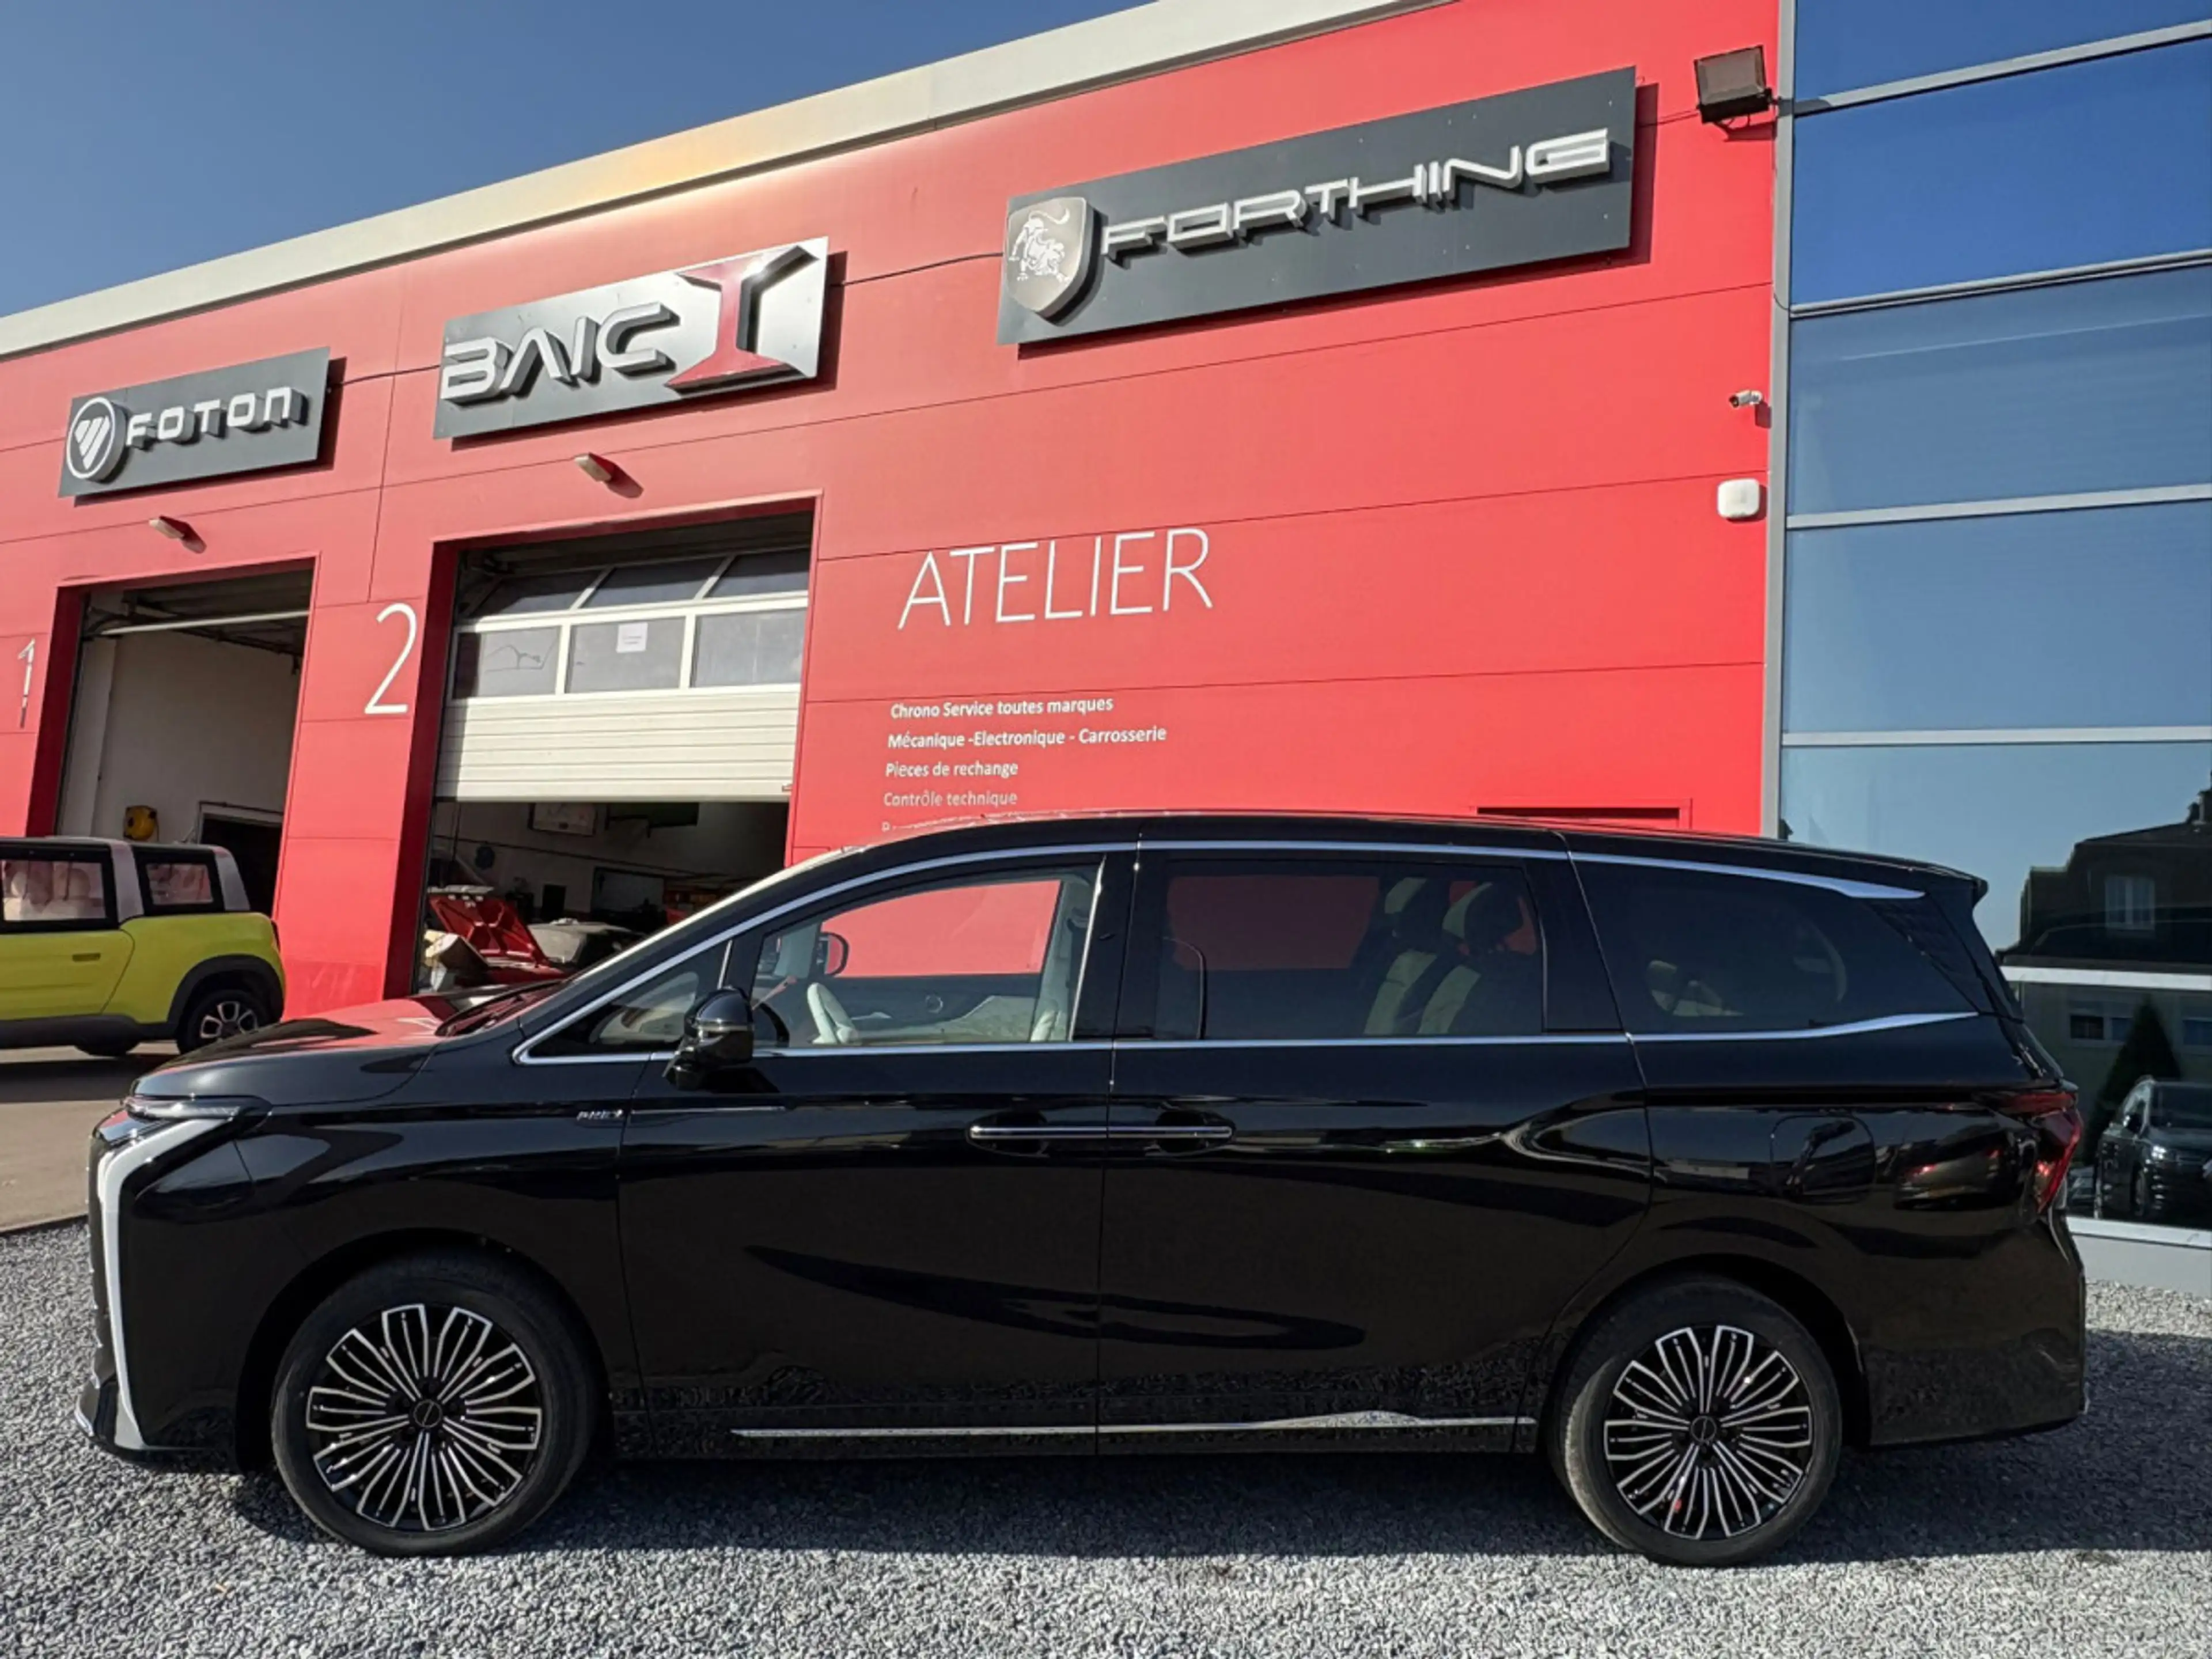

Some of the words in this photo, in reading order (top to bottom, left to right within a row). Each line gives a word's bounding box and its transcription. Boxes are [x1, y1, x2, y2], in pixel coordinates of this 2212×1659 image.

[1101, 127, 1611, 257] FORTHING
[441, 301, 671, 401] BAIC
[126, 385, 297, 447] FOTON
[897, 527, 1213, 630] ATELIER
[363, 603, 418, 715] 2
[888, 730, 965, 750] Mécanique
[1078, 725, 1167, 744] Carrosserie
[891, 703, 940, 718] Chrono
[942, 700, 993, 716] Service
[997, 700, 1044, 715] toutes
[1047, 698, 1114, 715] marques
[884, 789, 943, 806] Contrôle
[946, 790, 1018, 808] technique
[932, 760, 950, 776] de
[953, 760, 1018, 779] rechange
